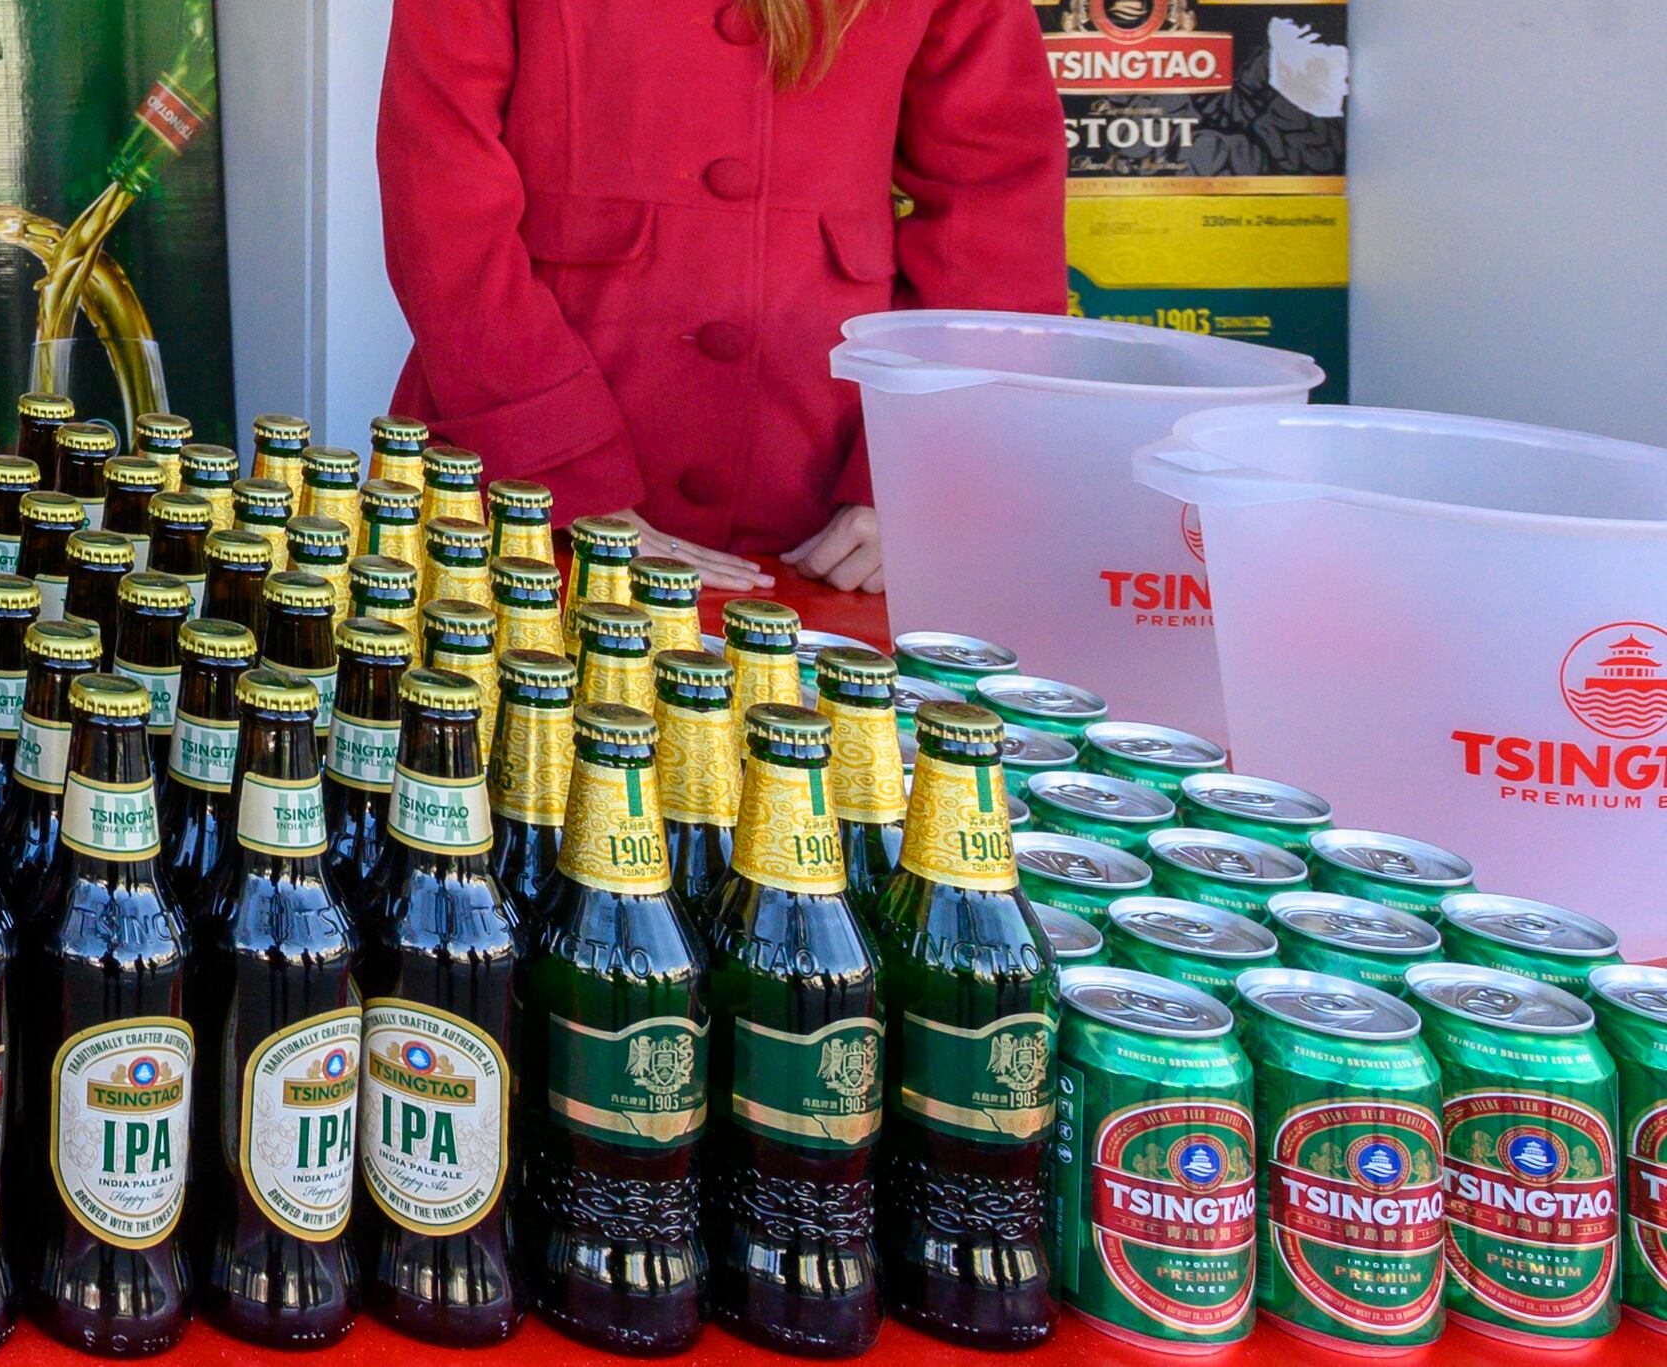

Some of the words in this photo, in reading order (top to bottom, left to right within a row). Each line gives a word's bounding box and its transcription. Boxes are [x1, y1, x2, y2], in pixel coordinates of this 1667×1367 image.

[1065, 118, 1198, 149] STOUT
[398, 793, 469, 819] TSINGTAO
[1500, 786, 1643, 809] PREMIUM
[424, 816, 447, 827] PALE
[451, 819, 469, 829] ALE
[608, 833, 664, 867] 1903
[68, 1037, 122, 1075] TRADITIONALLY
[125, 1032, 162, 1045] CRAFTED
[398, 1013, 440, 1035] CRAFTED
[441, 1025, 487, 1062] AUTHENTIC
[481, 1059, 496, 1078] ALE
[1448, 1034, 1497, 1055] TSINGTAO
[1500, 1050, 1548, 1063] BREWERY
[373, 1059, 469, 1099] TSINGTAO
[94, 1084, 180, 1107] TSINGTAO
[648, 1093, 679, 1112] 1903
[1513, 1101, 1539, 1112] BEER
[1551, 1106, 1589, 1127] CERVEZA
[382, 1092, 458, 1165] IPA
[102, 1117, 172, 1174] IPA
[379, 1149, 406, 1167] INDIA
[410, 1162, 438, 1178] PALE
[441, 1170, 463, 1180] ALE
[465, 1187, 485, 1209] HOPS
[1105, 1178, 1255, 1224] TSINGTAO
[1443, 1167, 1612, 1219] TSINGTAO
[74, 1188, 107, 1222] BREWED
[109, 1217, 133, 1232] WITH
[135, 1219, 151, 1232] THE
[152, 1205, 175, 1228] FINEST
[1486, 1252, 1581, 1278] PREMIUM
[1499, 1246, 1570, 1263] IMPORTED
[1157, 1266, 1238, 1281] PREMIUM
[1507, 1271, 1566, 1288] LAGER
[1175, 1284, 1226, 1294] LAGER
